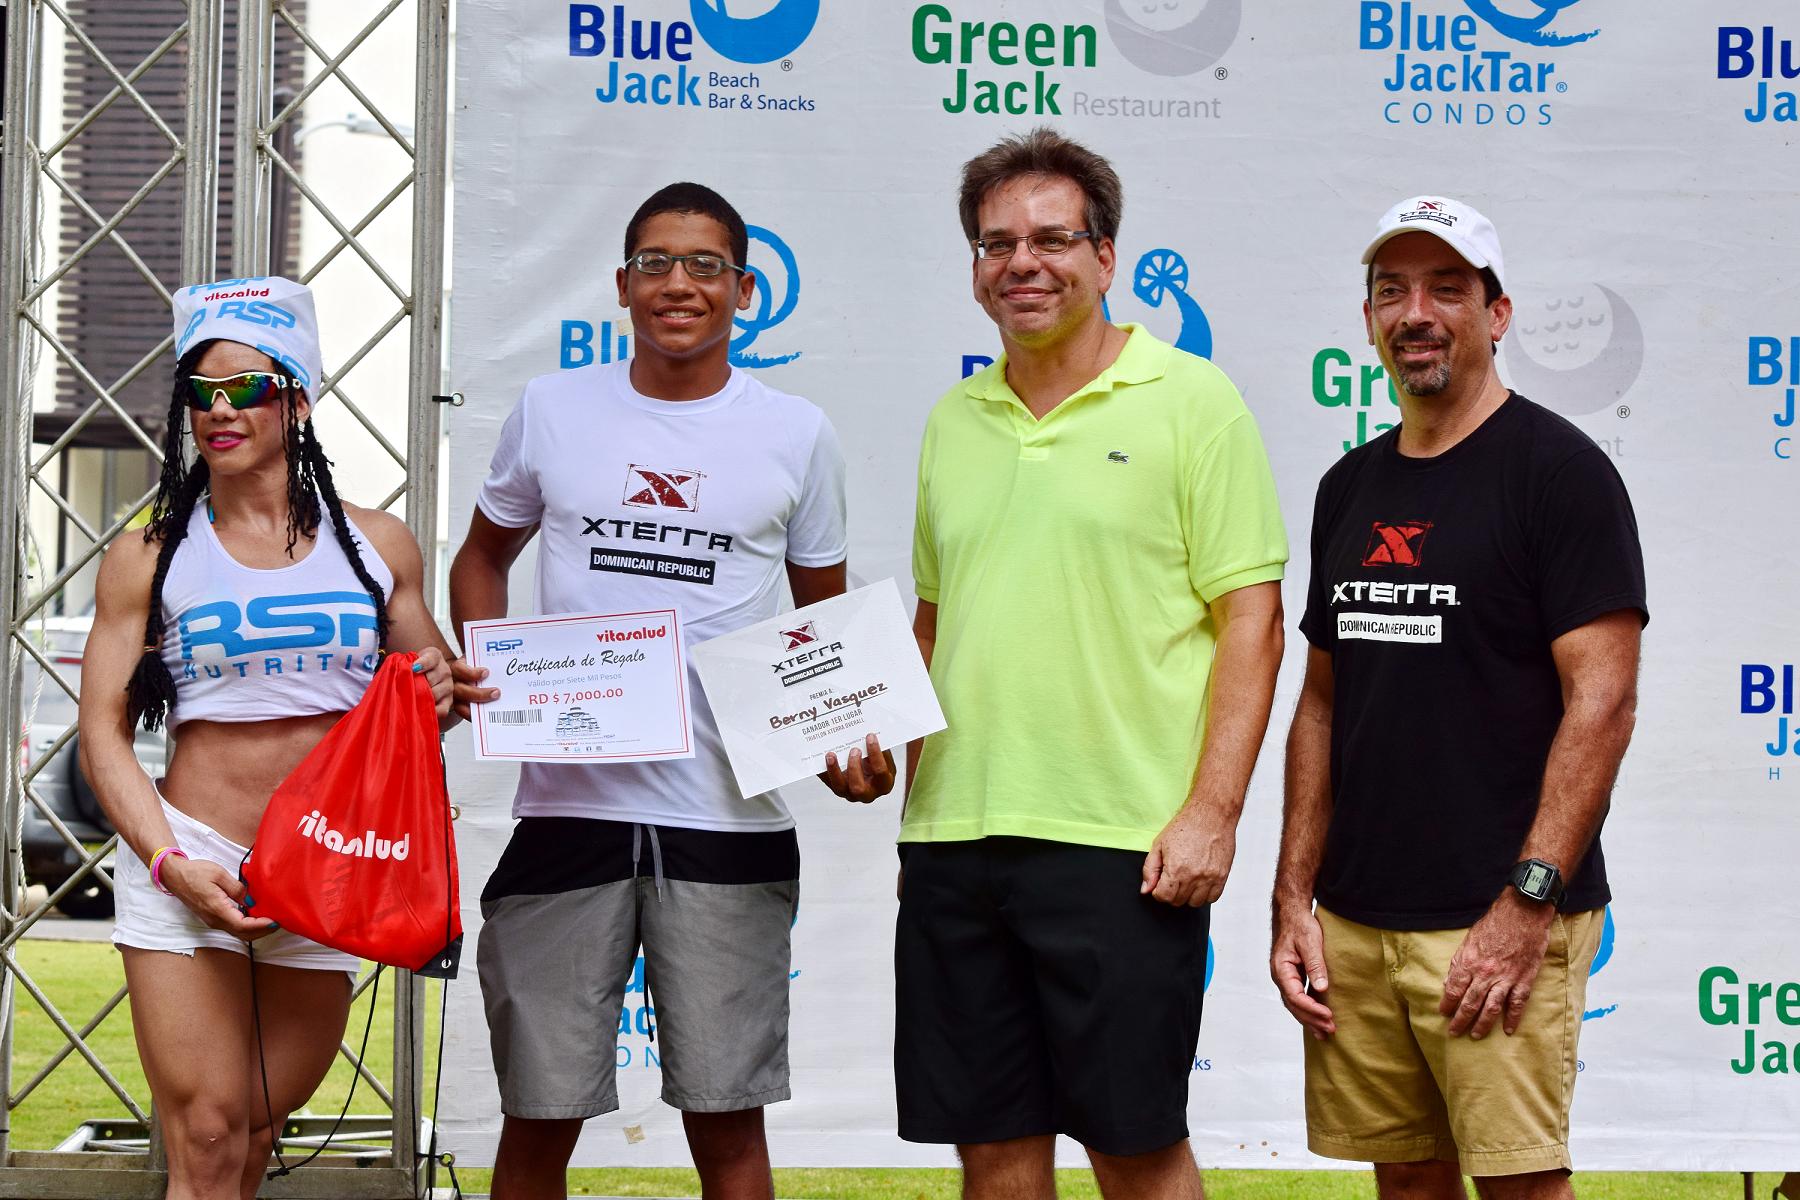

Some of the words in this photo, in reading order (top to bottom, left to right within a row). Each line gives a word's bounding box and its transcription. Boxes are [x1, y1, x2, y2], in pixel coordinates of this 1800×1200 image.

[569, 4, 693, 62] Blue
[912, 4, 1096, 67] Green
[1360, 1, 1477, 51] Blue
[1718, 26, 1800, 79] Blu
[596, 62, 702, 106] Jack
[709, 72, 760, 88] Beach
[1384, 52, 1554, 92] JackTar
[709, 94, 736, 109] Bar
[740, 94, 752, 109] &
[758, 95, 815, 111] Snacks
[942, 69, 1062, 115] Jack
[1073, 92, 1222, 118] Restaurant
[1744, 82, 1799, 122] Ja
[1384, 102, 1552, 125] CONDOS
[205, 288, 269, 302] vitasalud
[216, 301, 296, 329] RSP
[560, 320, 628, 369] Bl
[1749, 336, 1800, 385] Bl
[580, 516, 733, 553] XTERRA
[594, 554, 654, 571] DOMINICAN
[657, 560, 711, 579] REPUBLIC
[1331, 581, 1458, 606] XTERRA
[597, 626, 667, 643] vitasalud
[1391, 623, 1436, 637] REPUBLIC
[486, 639, 523, 652] RSP
[771, 641, 843, 674] XTERRA
[184, 654, 374, 679] NUTRITIO
[506, 656, 576, 676] Certificado
[581, 654, 595, 667] de
[601, 648, 646, 668] Regalo
[784, 669, 814, 685] DOMINICAN
[815, 660, 840, 673] REPUBLIC
[552, 679, 565, 687] por
[567, 676, 585, 684] Siete
[810, 690, 828, 700] PREMIA
[1741, 664, 1793, 714] Bl
[529, 694, 548, 705] RD
[553, 692, 559, 704] $
[564, 688, 623, 705] 7,000.00
[769, 706, 817, 729] Berny
[823, 683, 888, 707] Vasquez
[802, 720, 830, 735] GANADOR
[832, 715, 843, 725] 1ER
[843, 708, 863, 720] LUGAR
[1698, 966, 1800, 1025] Gre
[1731, 1029, 1800, 1074] Ja
